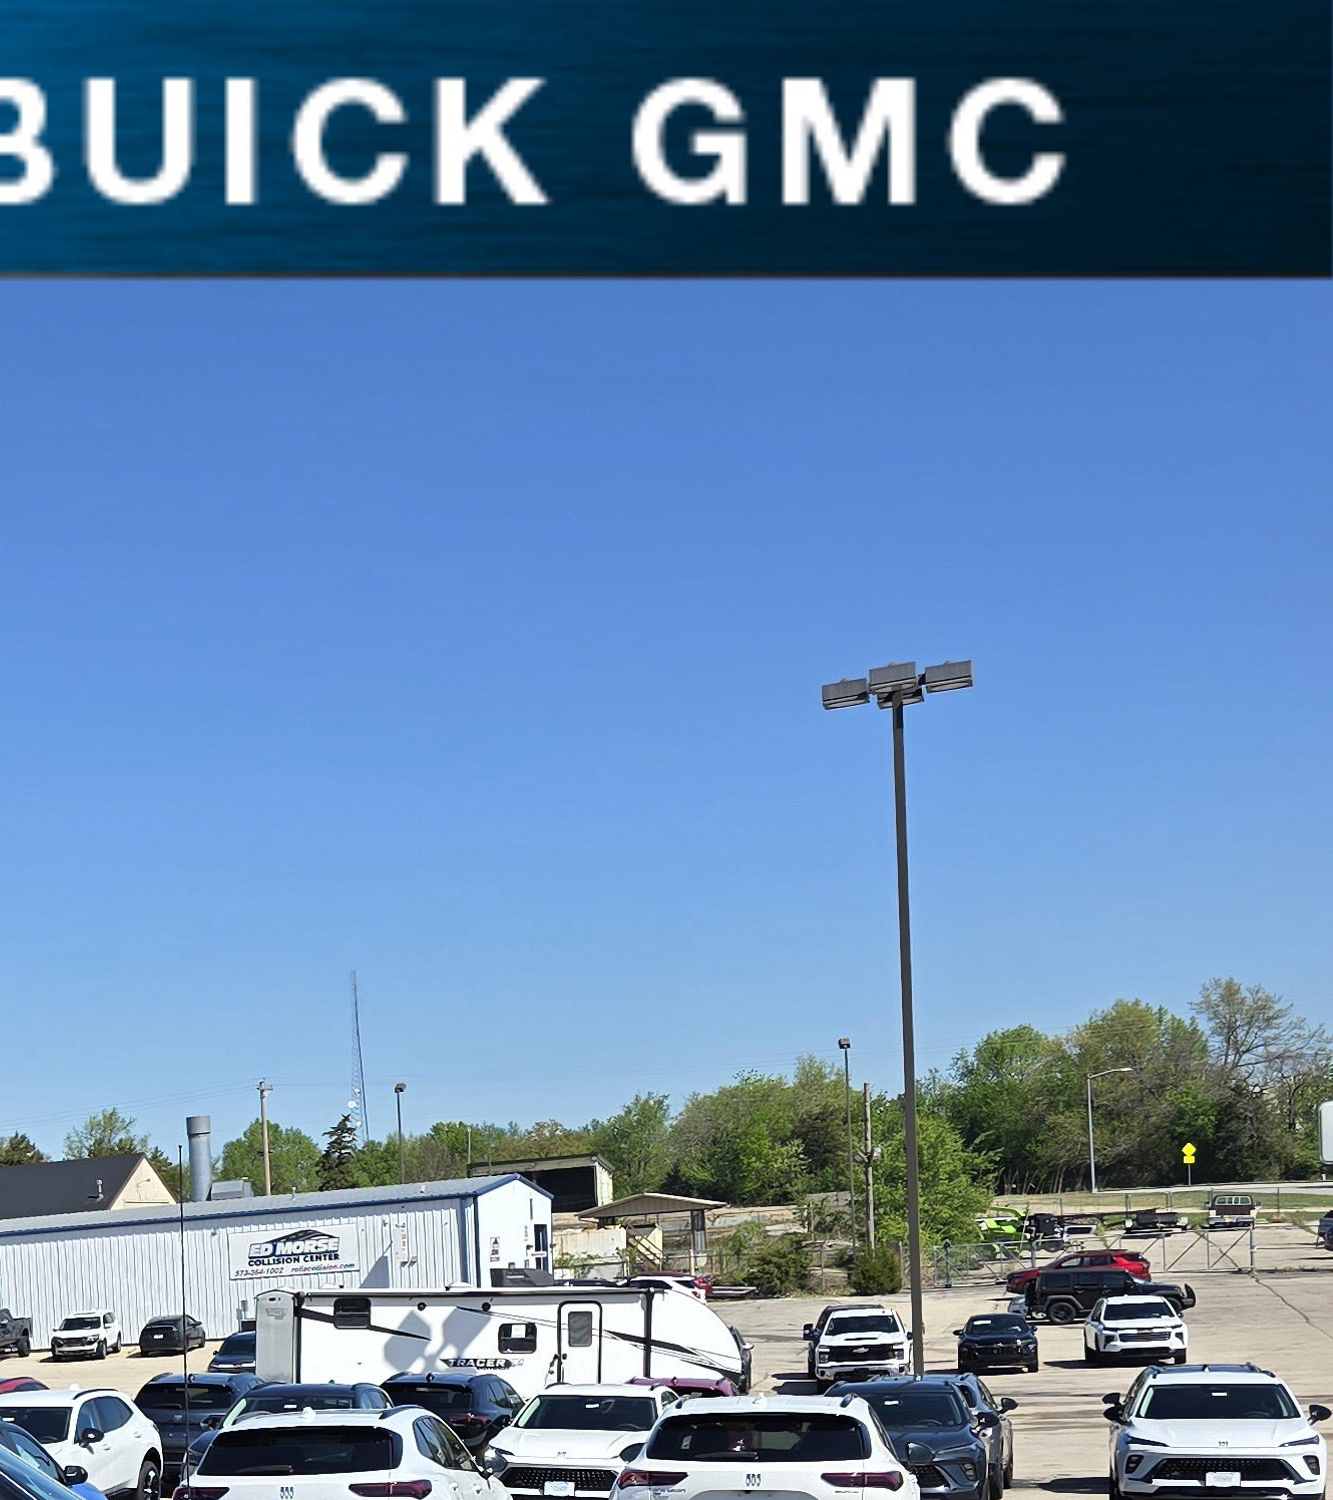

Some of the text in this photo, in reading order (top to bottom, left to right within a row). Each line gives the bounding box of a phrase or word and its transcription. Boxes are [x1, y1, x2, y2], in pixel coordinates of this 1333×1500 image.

[249, 1237, 339, 1257] ED MORSE
[248, 1252, 340, 1267] COLLISION CENTER
[449, 1358, 506, 1368] TRACER
